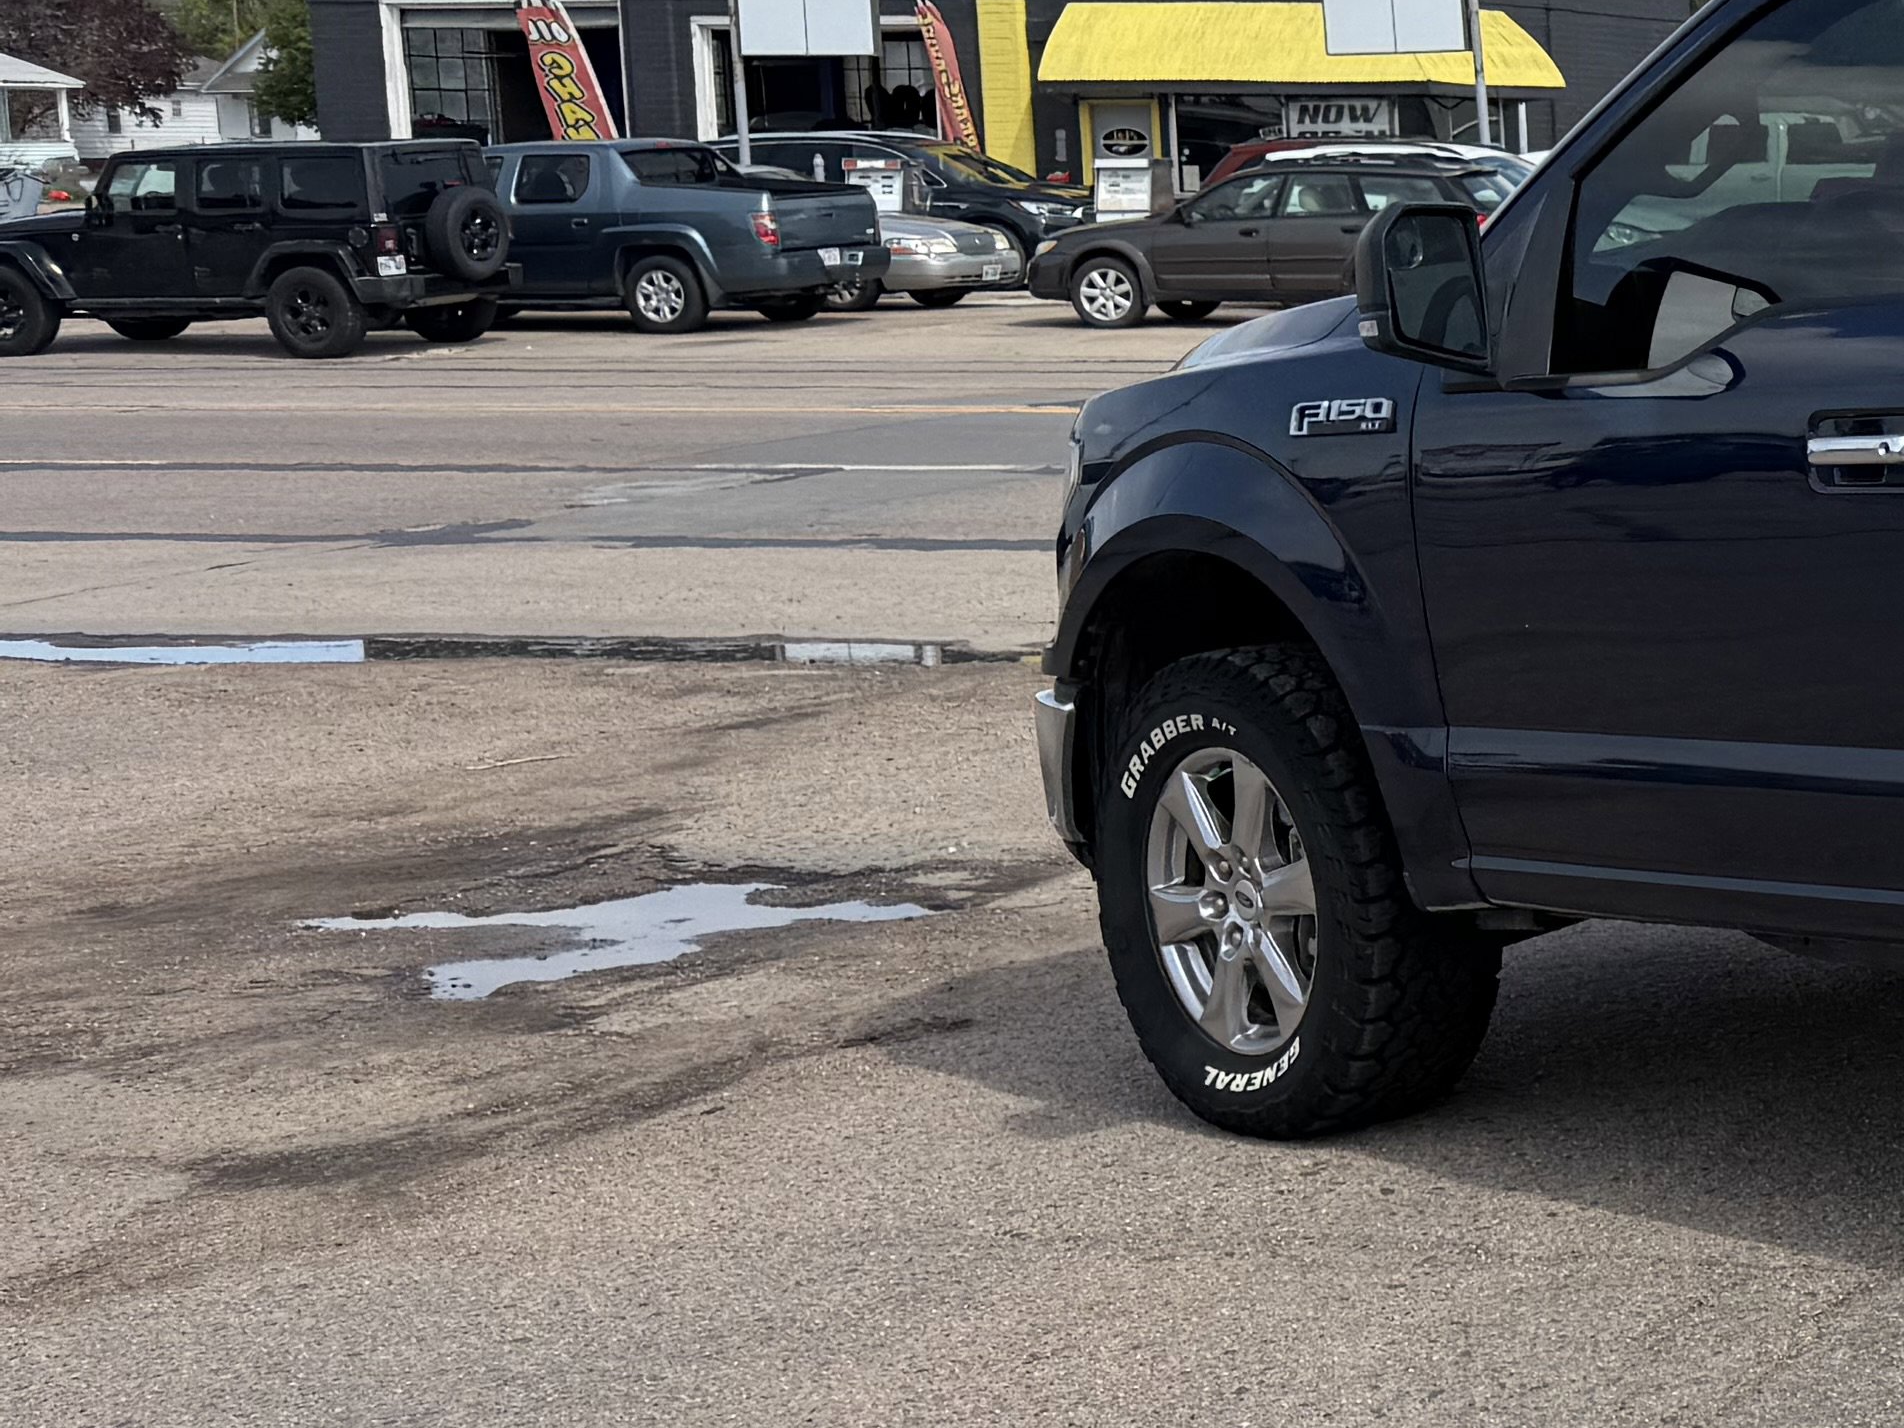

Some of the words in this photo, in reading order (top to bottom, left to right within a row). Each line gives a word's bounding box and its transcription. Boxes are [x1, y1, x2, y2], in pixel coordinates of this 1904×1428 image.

[1297, 104, 1382, 125] NOW
[1120, 713, 1205, 800] GRABBER
[1211, 717, 1237, 736] A/T
[1204, 1035, 1300, 1093] GENERAL
